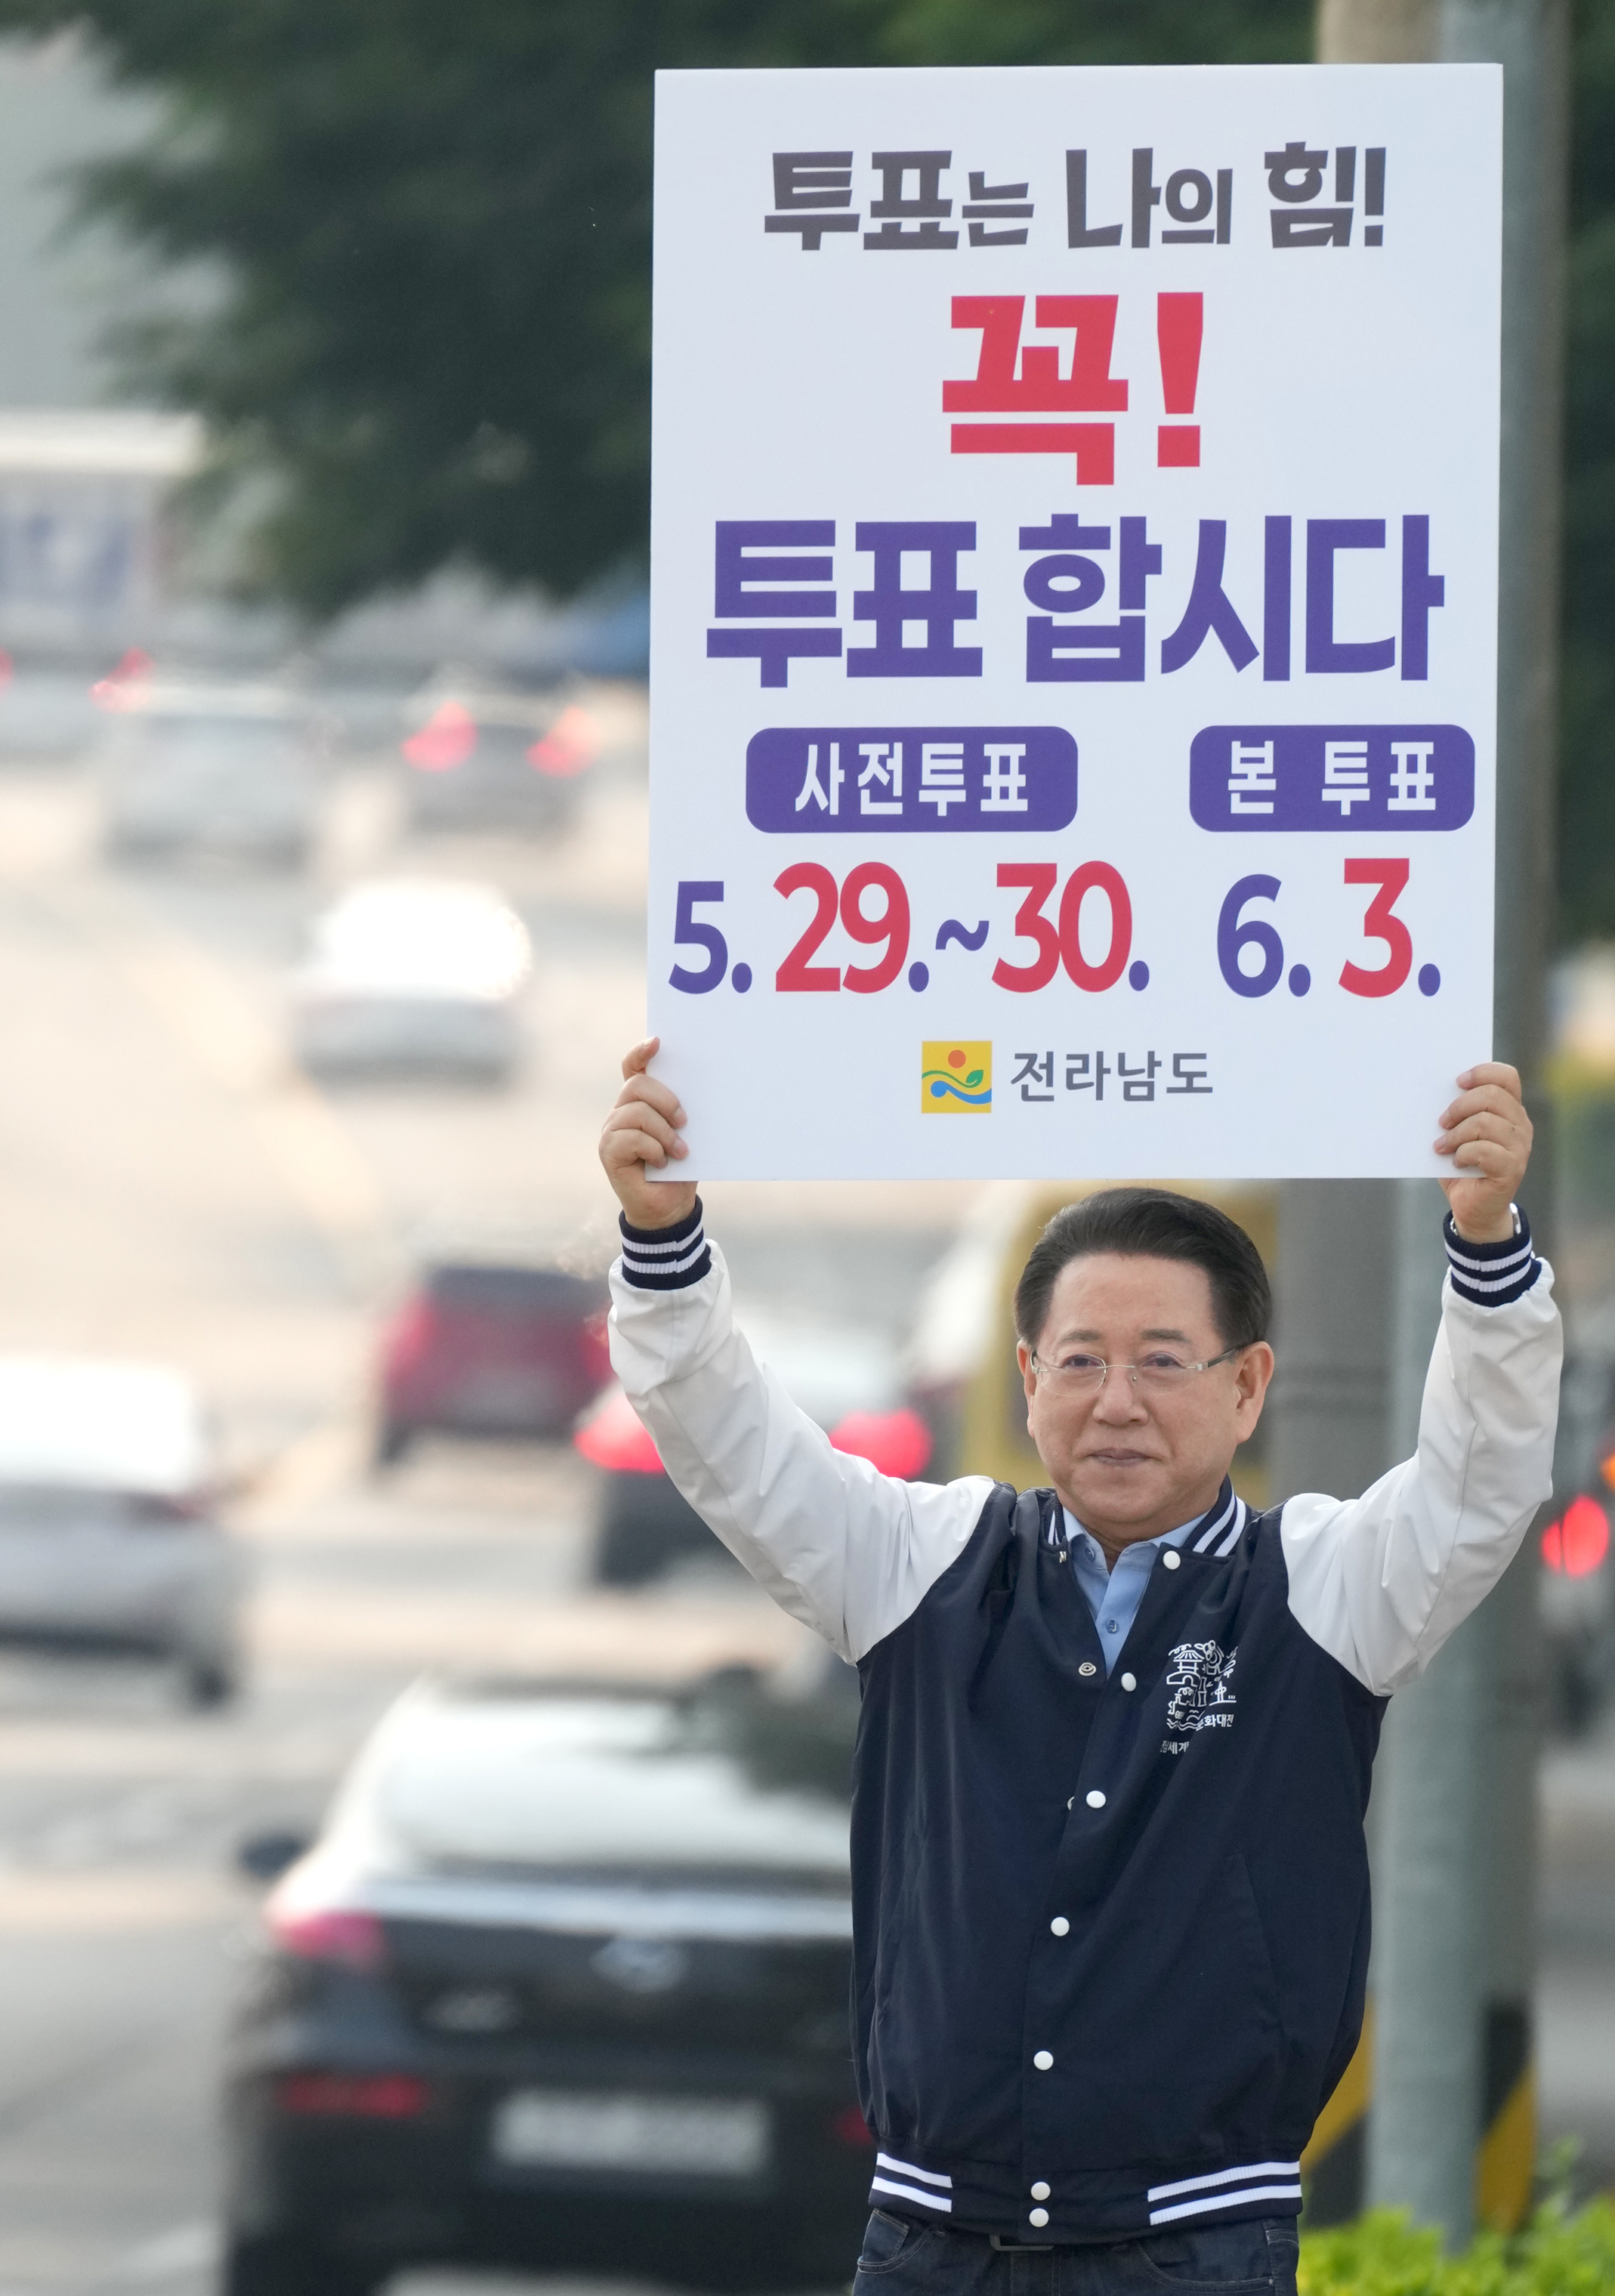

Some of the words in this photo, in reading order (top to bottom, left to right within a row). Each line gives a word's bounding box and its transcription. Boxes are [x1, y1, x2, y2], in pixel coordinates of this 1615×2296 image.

[764, 150, 1035, 251] 투표는
[1066, 147, 1233, 249] 나의
[1264, 141, 1387, 249] 힘!
[942, 292, 1204, 486] 꼭!
[706, 520, 984, 688] 투표
[1018, 513, 1445, 683] 합시다
[795, 741, 1029, 817] 사전투표
[1227, 740, 1277, 814] 본
[1321, 740, 1437, 816] 투표
[669, 880, 753, 995] 5.
[1217, 873, 1312, 999] 6.
[1338, 858, 1441, 999] 3.
[1011, 1050, 1213, 1102] 전라남도
